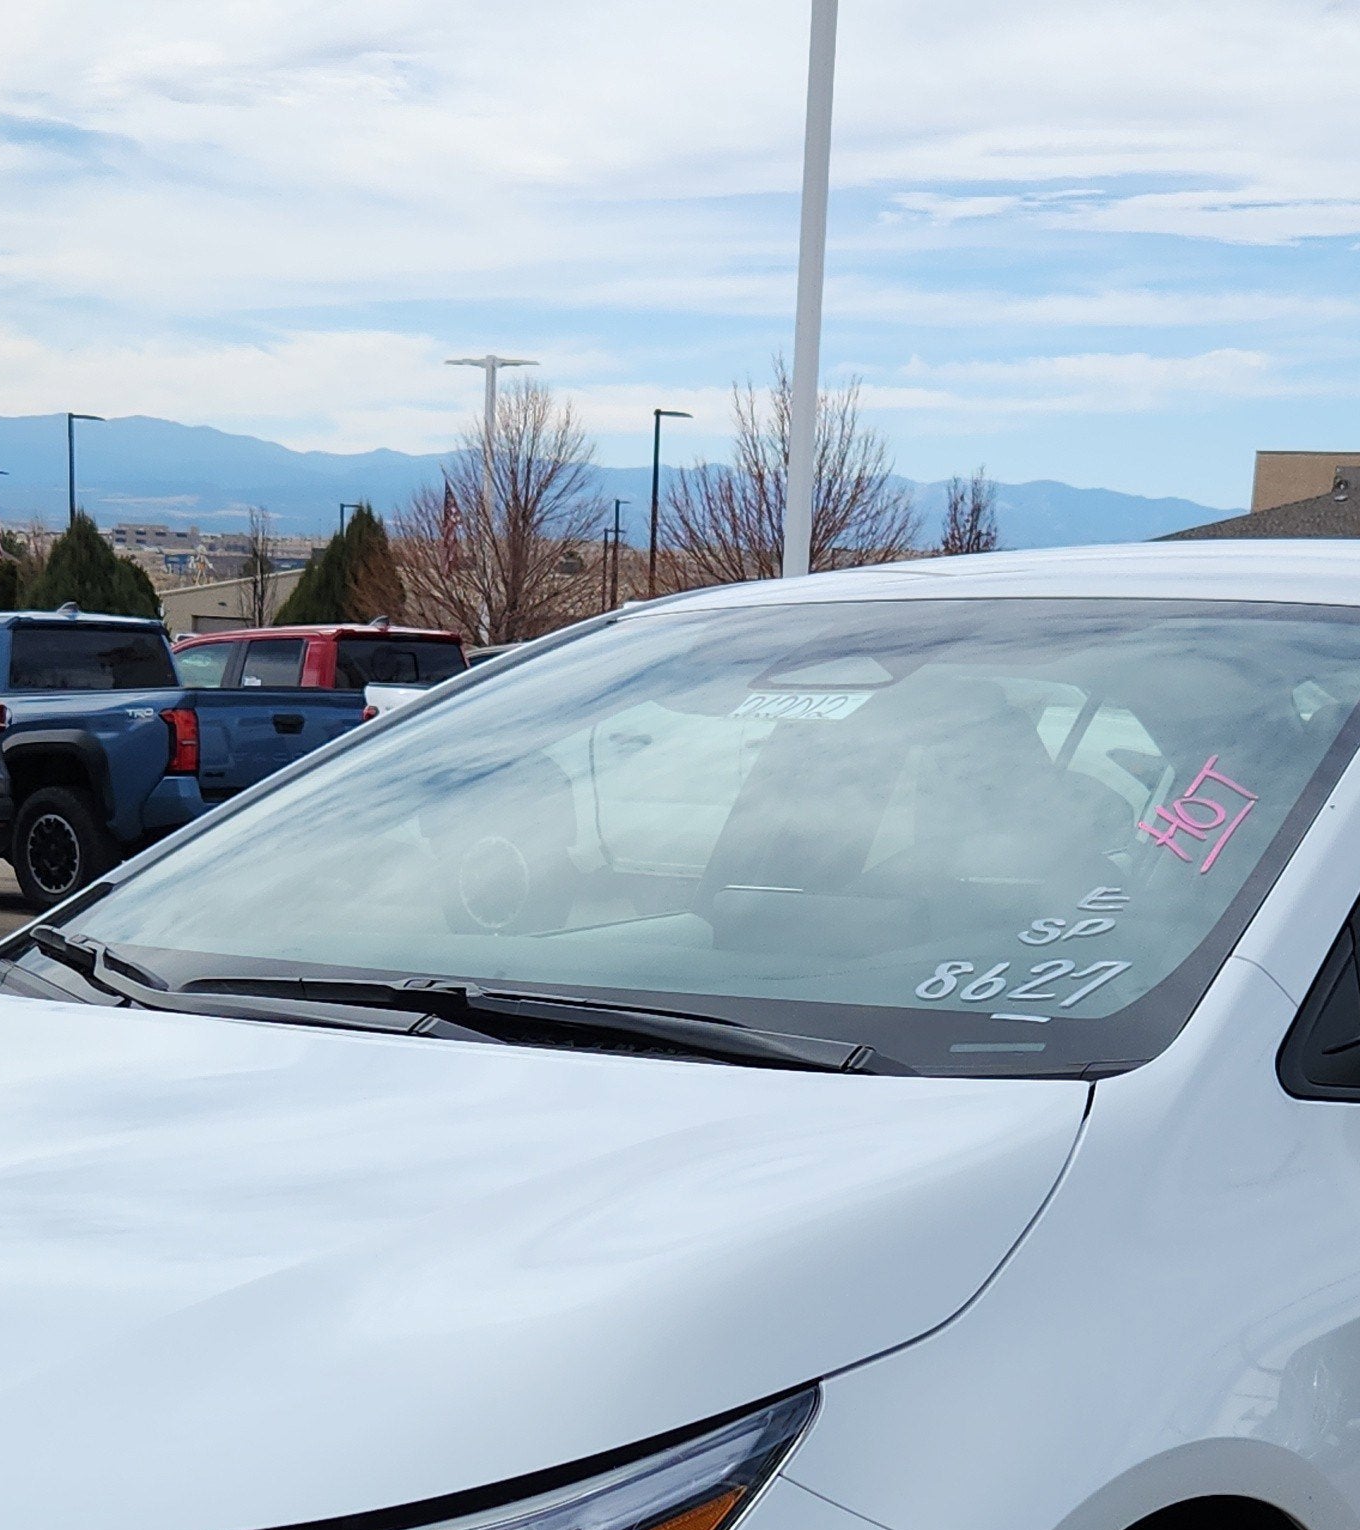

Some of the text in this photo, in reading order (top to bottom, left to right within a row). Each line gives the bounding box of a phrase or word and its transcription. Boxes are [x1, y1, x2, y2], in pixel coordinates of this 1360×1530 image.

[126, 708, 153, 719] TRD
[1138, 755, 1258, 862] HOT
[1077, 886, 1130, 912] E
[1017, 918, 1116, 946] SP
[915, 959, 1133, 1008] 8627
